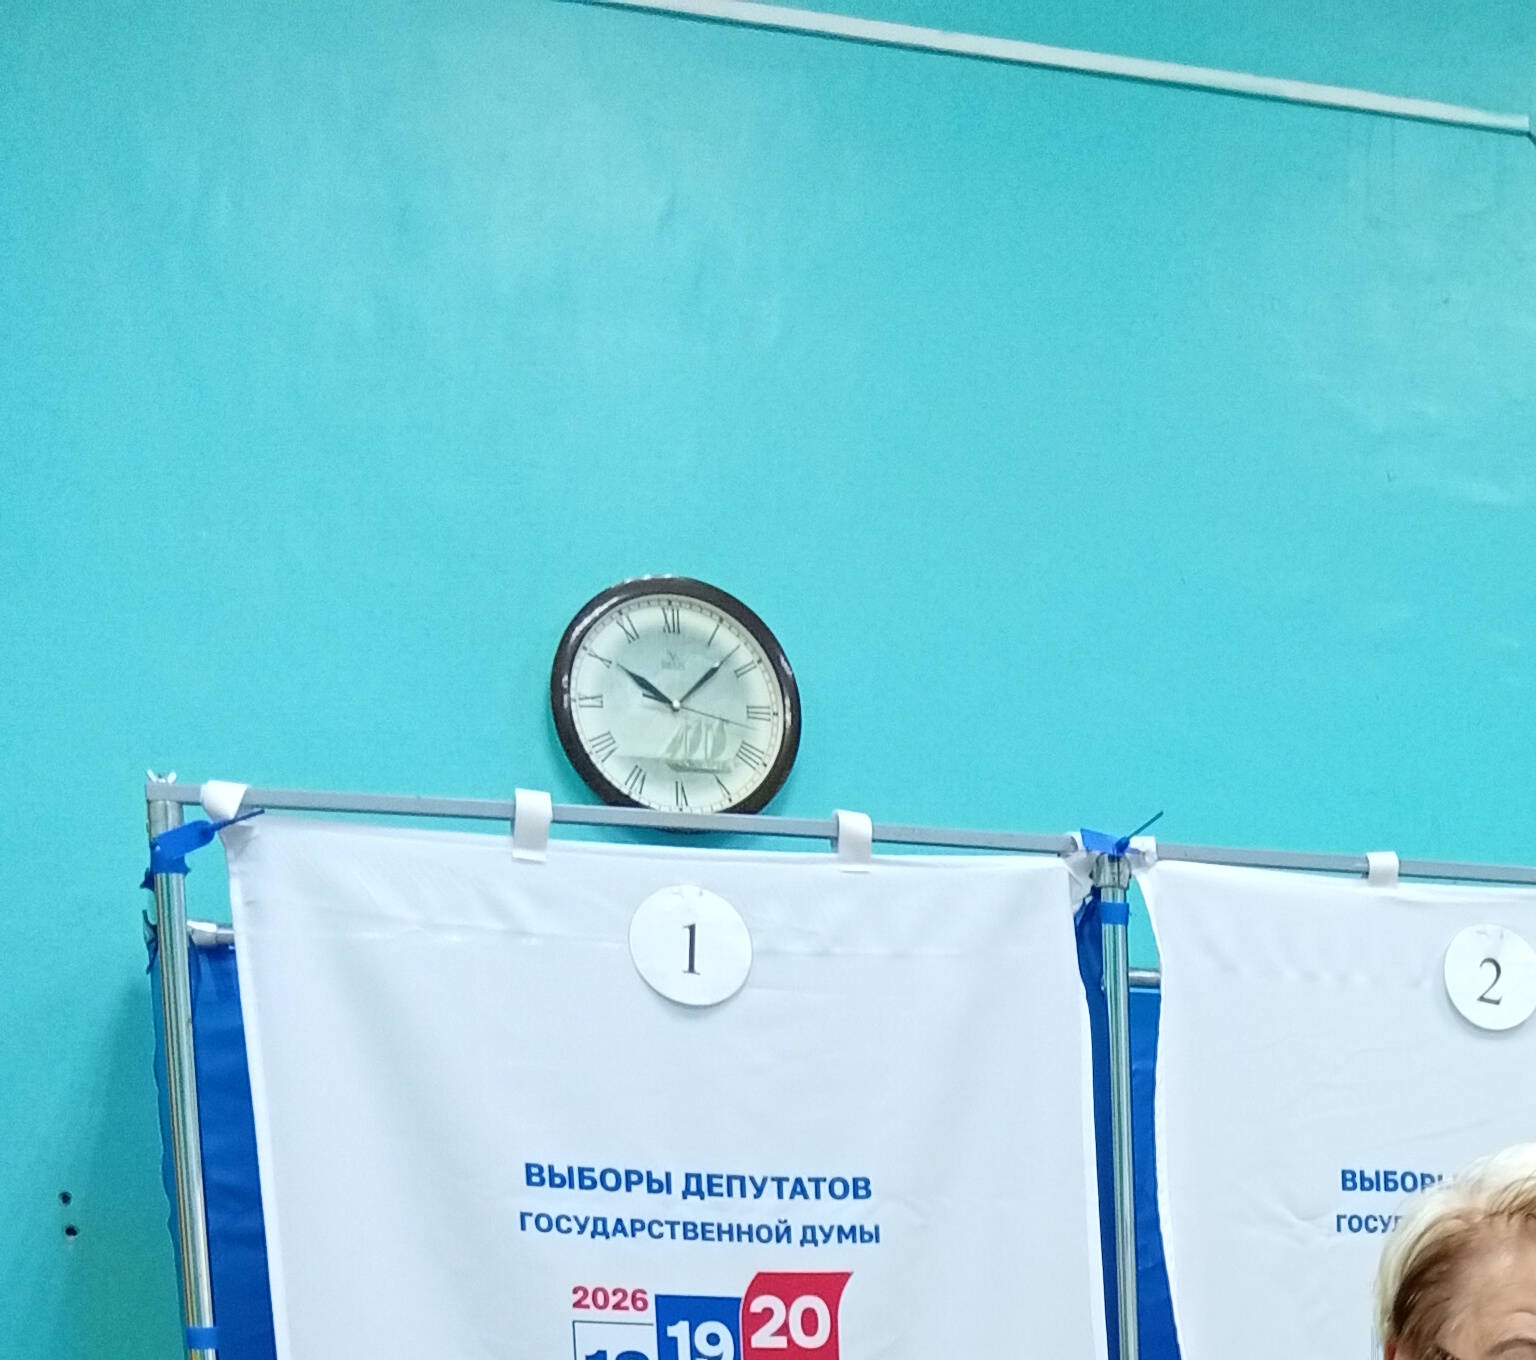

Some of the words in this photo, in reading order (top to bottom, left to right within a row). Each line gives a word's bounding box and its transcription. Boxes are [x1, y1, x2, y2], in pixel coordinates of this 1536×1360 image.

[682, 923, 701, 975] 1
[1477, 957, 1503, 1006] 2
[524, 1162, 673, 1197] ВЫБОРЫ
[681, 1171, 873, 1201] ДЕПУТАТОВ
[1340, 1169, 1443, 1193] ВЫБОР
[519, 1211, 793, 1245] ГОСУДАРСТВЕННОЙ
[799, 1223, 881, 1248] ДУМЫ
[571, 1285, 649, 1312] 2026
[749, 1294, 832, 1350] 20
